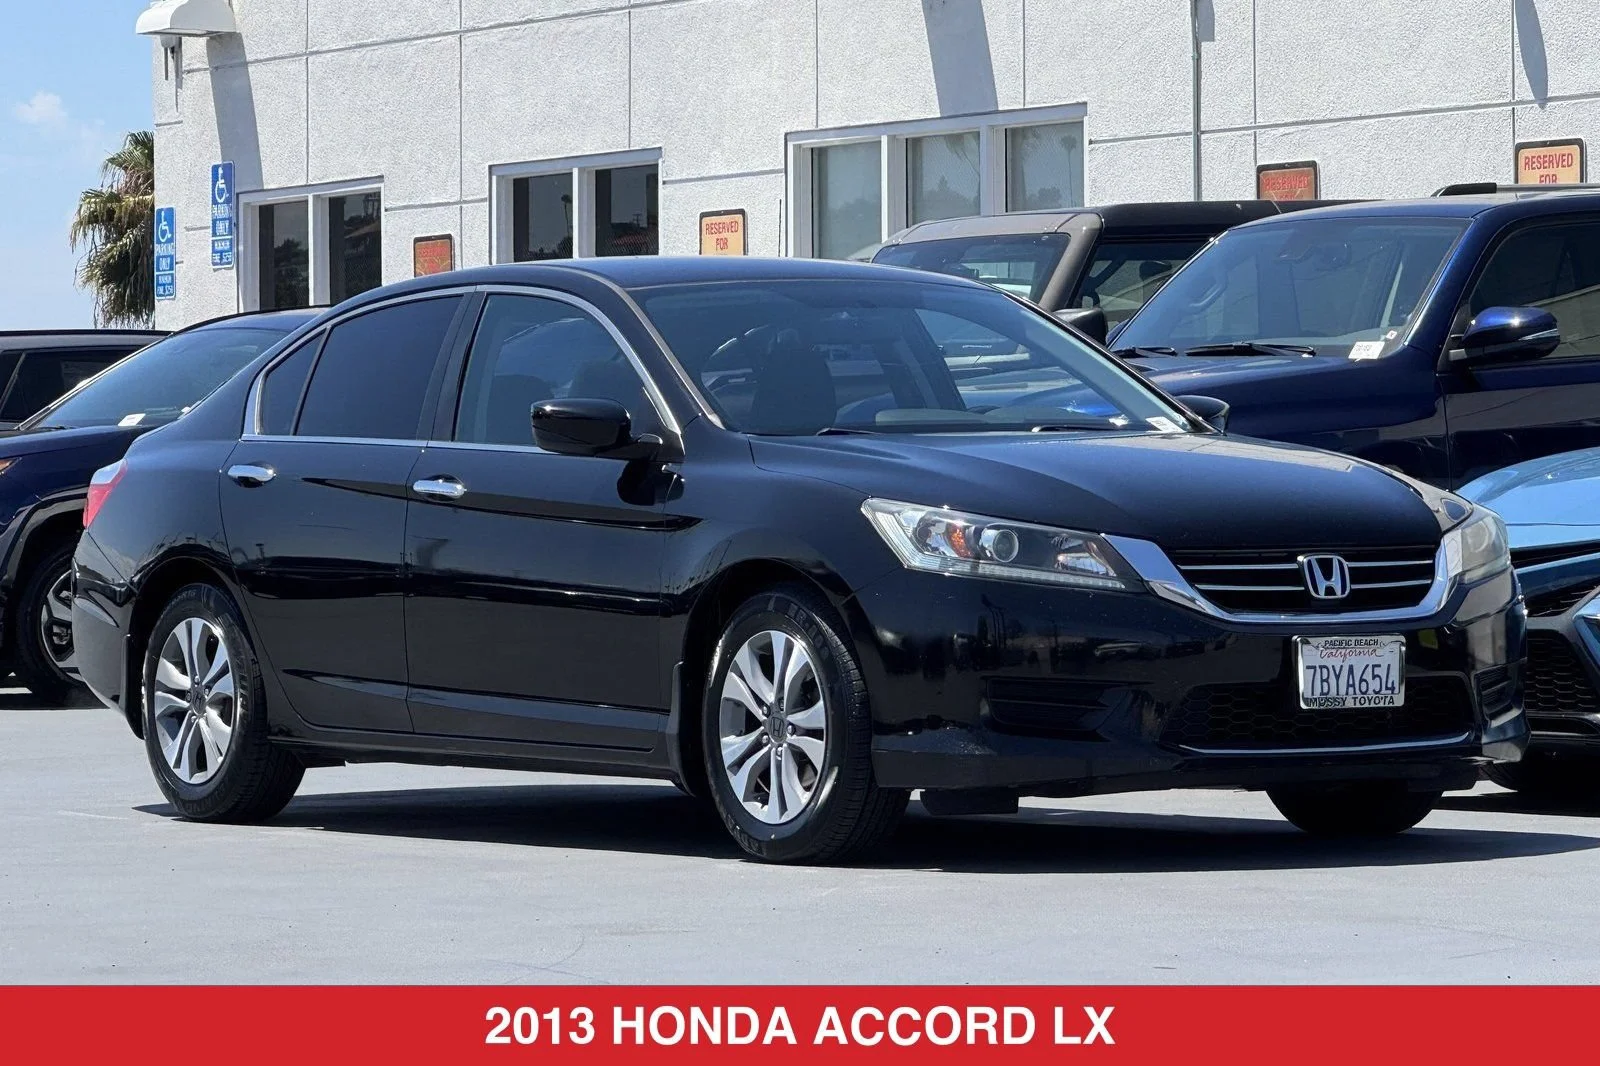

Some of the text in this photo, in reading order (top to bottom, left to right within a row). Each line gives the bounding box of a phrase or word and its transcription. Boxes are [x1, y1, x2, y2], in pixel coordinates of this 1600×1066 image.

[1524, 153, 1573, 170] RESERVED
[1539, 174, 1557, 184] FOR
[212, 204, 232, 219] PARKING
[215, 220, 229, 236] ONLY
[705, 221, 739, 236] RESERVED
[155, 243, 175, 256] PARKING
[715, 238, 729, 251] FOR
[159, 257, 170, 271] ONLY
[1307, 556, 1347, 598] H
[1324, 638, 1380, 648] PACIFIC BEACH
[1319, 648, 1385, 663] California
[1305, 663, 1396, 697] 7BYA654
[1309, 695, 1396, 708] MOSSY TOYOTA
